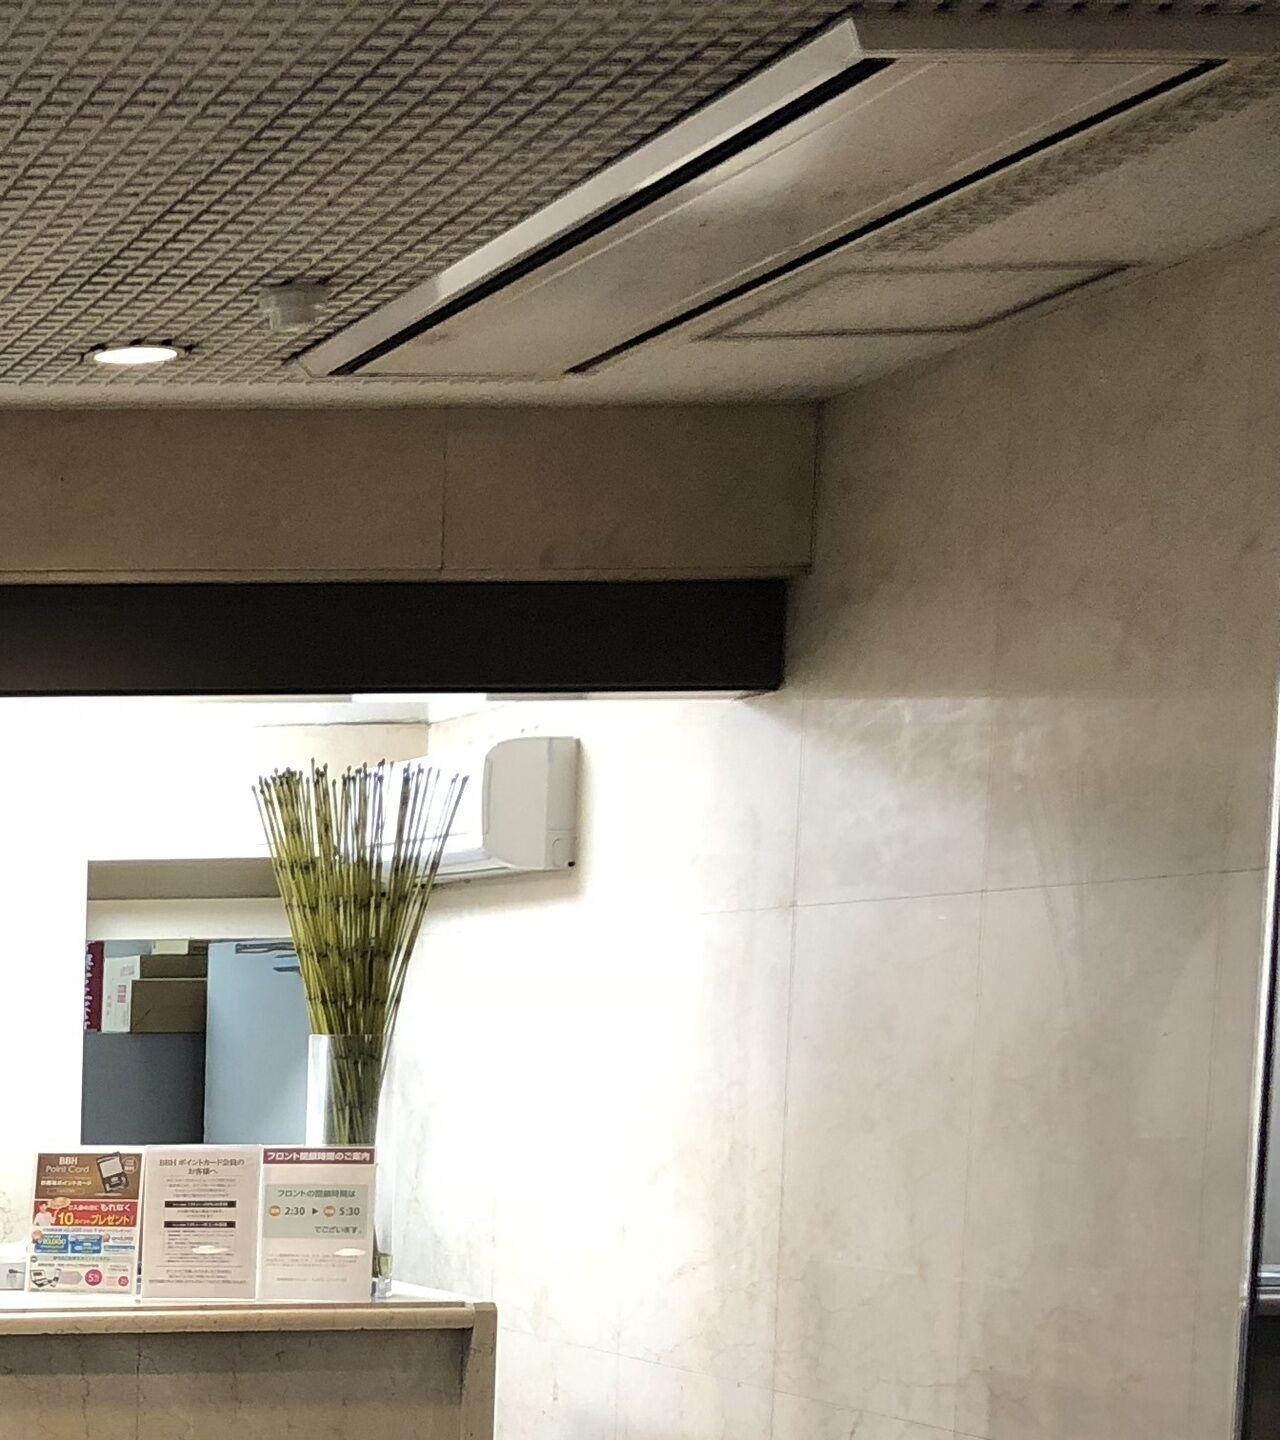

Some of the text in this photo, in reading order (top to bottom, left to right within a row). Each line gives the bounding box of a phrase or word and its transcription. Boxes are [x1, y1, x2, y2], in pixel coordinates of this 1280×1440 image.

[59, 1156, 78, 1165] BBH
[46, 1165, 89, 1173] Point Card
[284, 1206, 306, 1216] 2:30
[338, 1206, 361, 1216] 5:30
